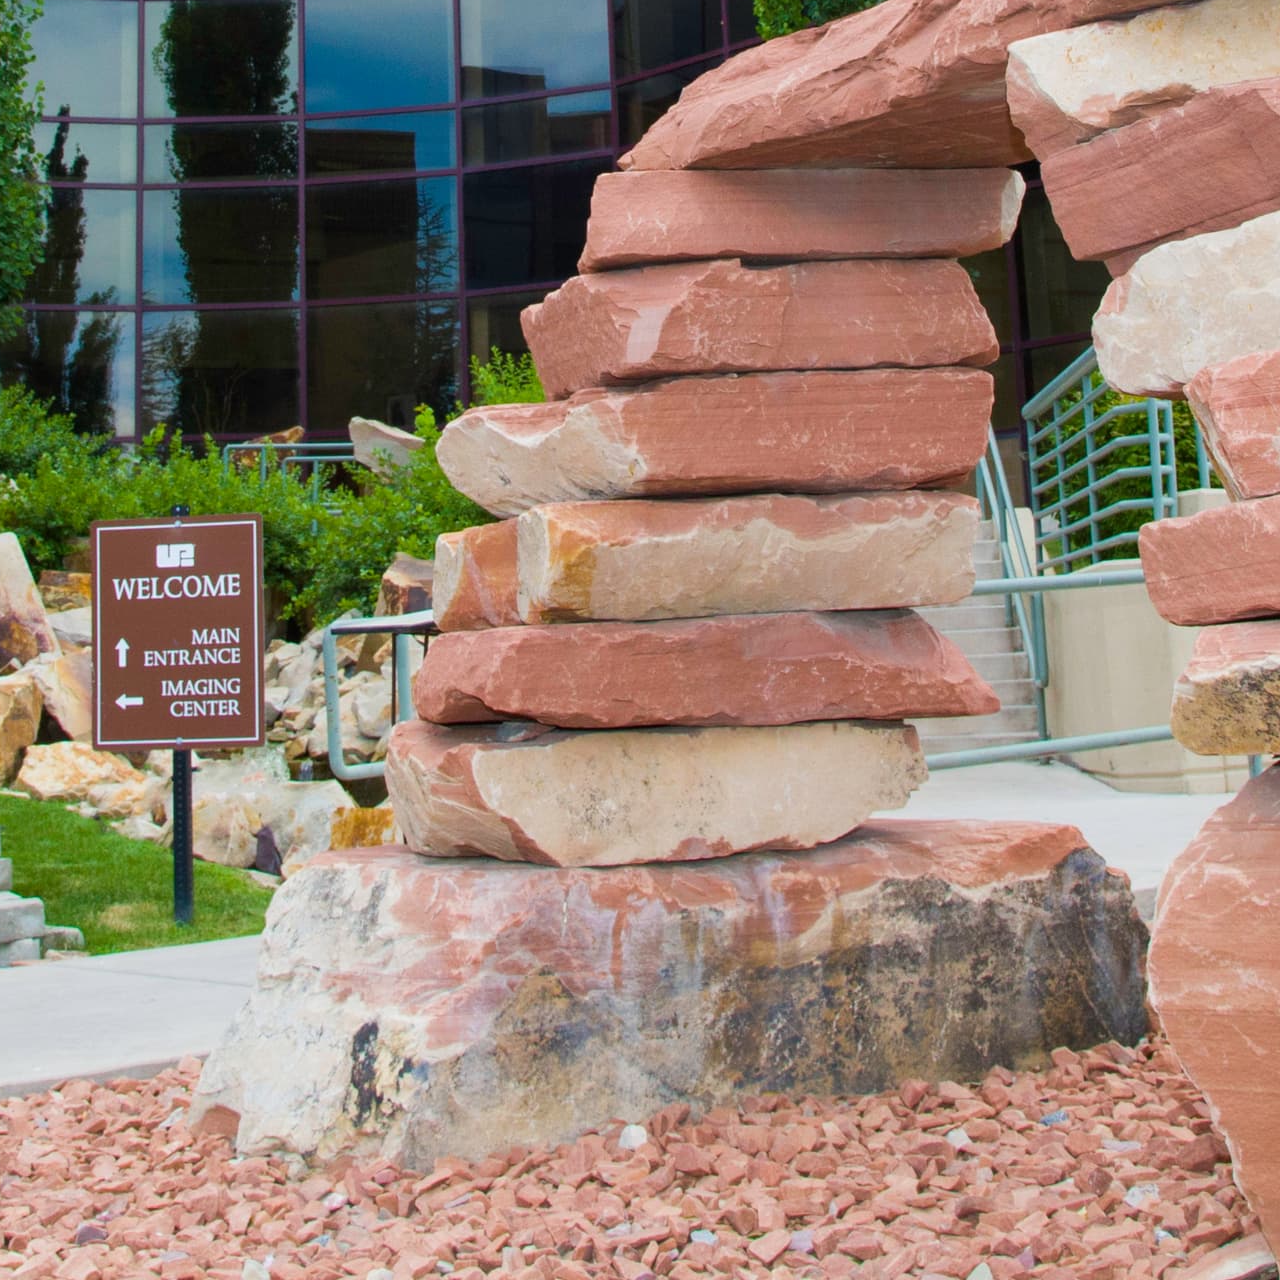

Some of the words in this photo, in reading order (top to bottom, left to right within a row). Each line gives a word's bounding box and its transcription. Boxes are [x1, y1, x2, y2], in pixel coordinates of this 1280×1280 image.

[112, 573, 241, 600] WELCOME
[191, 627, 241, 646] MAIN
[143, 647, 241, 667] ENTRANCE
[161, 677, 241, 697] IMAGING
[169, 699, 241, 718] CENTER
